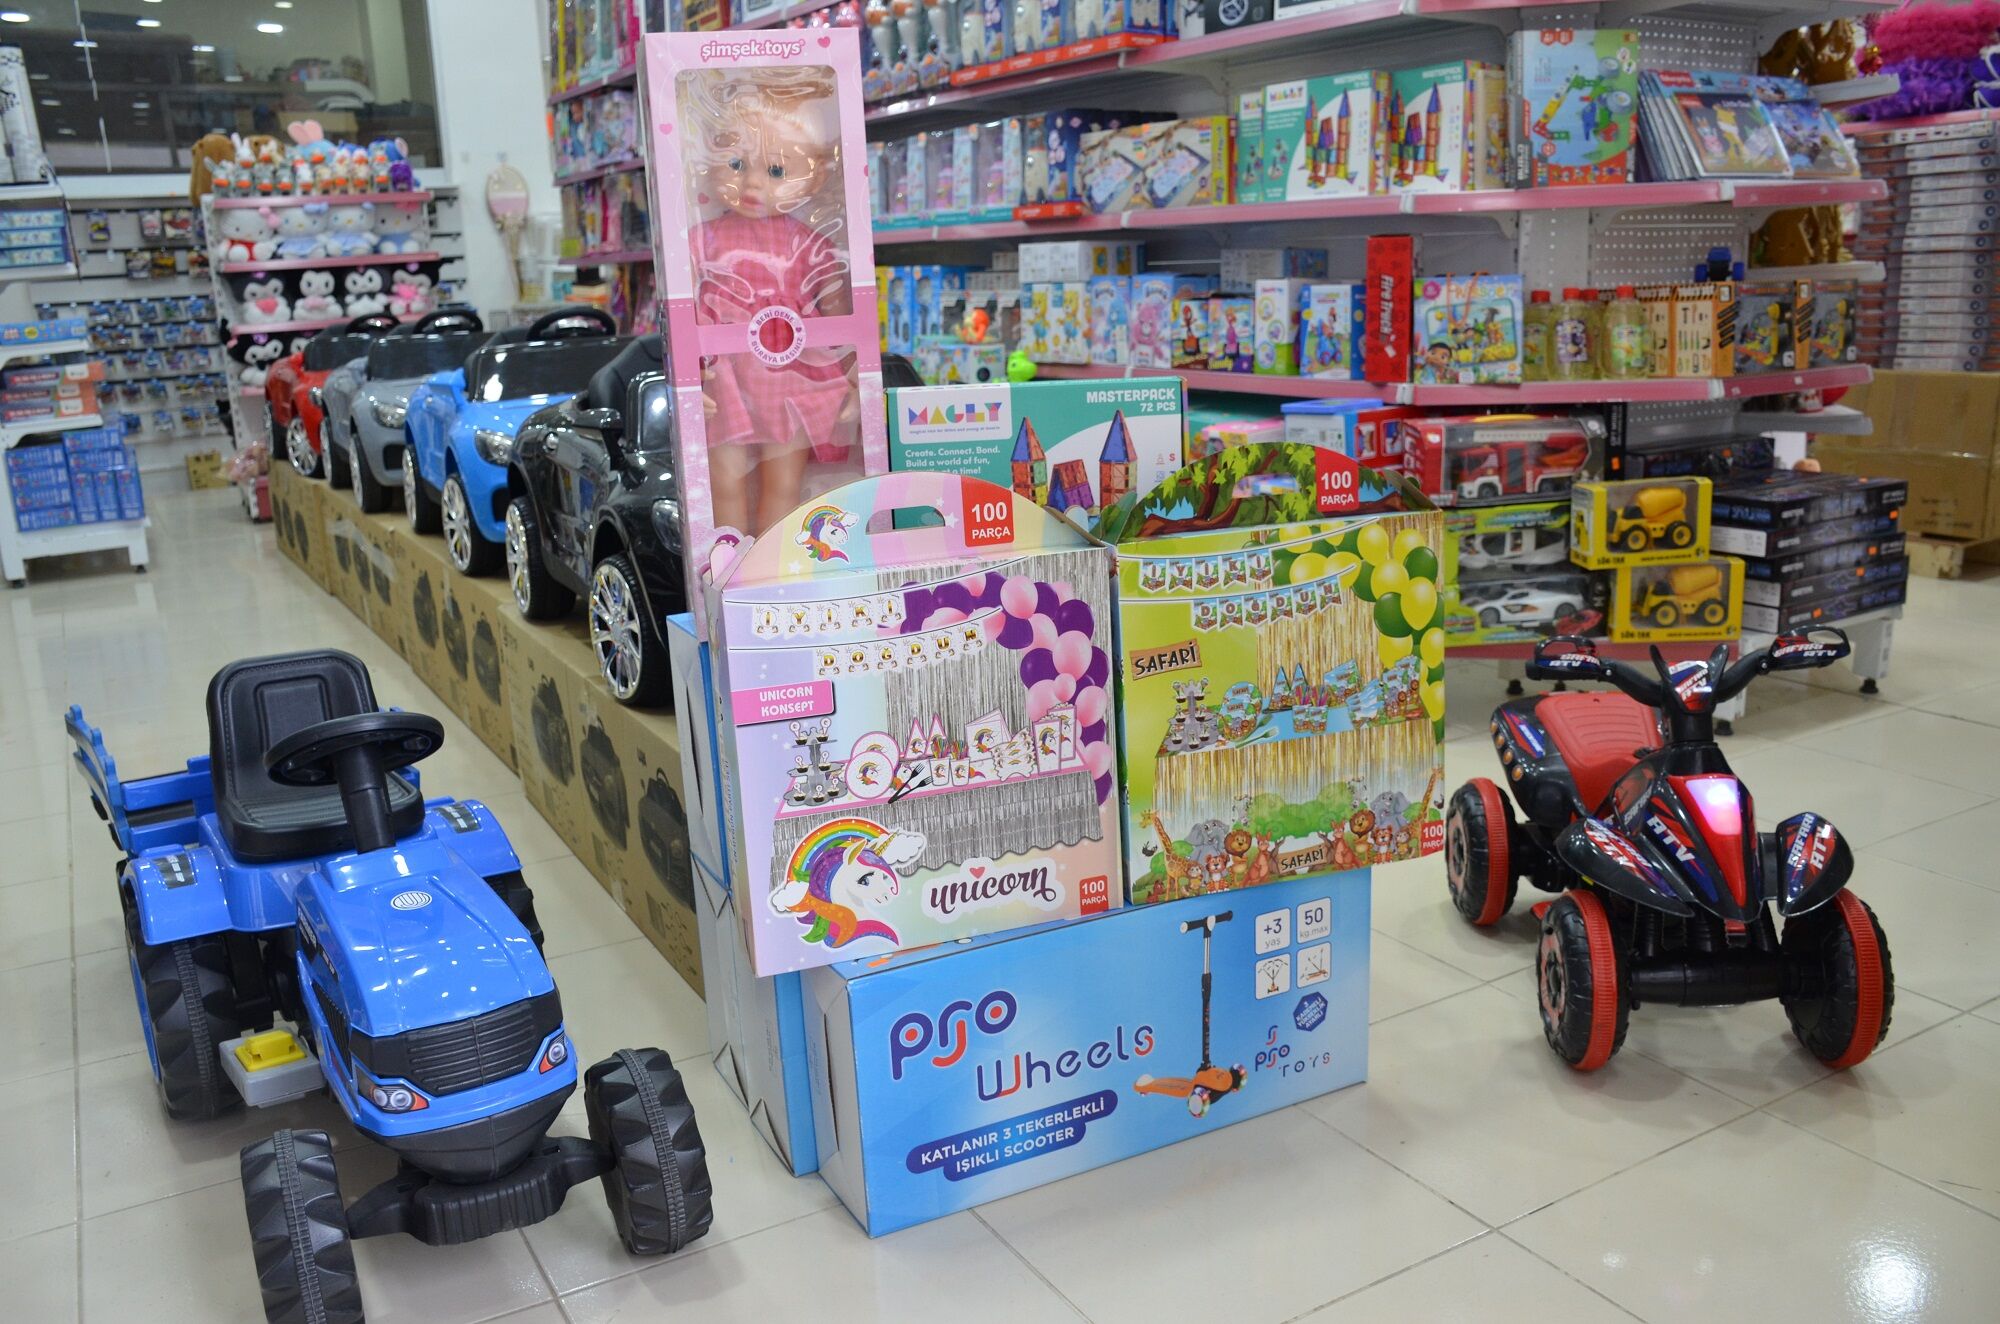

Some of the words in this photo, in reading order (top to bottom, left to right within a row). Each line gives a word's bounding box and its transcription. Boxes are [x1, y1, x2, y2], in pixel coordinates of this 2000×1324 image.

[701, 40, 801, 61] şimşek.toys
[755, 310, 773, 326] BENİ
[774, 310, 794, 323] DENE
[751, 340, 778, 363] BURAYA
[1086, 388, 1176, 403] MASTERPACK
[908, 402, 1003, 425] MAGLY
[1140, 403, 1153, 412] 72
[1156, 401, 1176, 411] PCS
[905, 449, 936, 458] Create.
[938, 446, 975, 457] Connect.
[976, 445, 1001, 454] Bond.
[905, 459, 927, 468] Build
[936, 457, 963, 466] world
[964, 456, 973, 465] of
[973, 456, 990, 465] fun,
[1321, 470, 1352, 490] 100
[1321, 493, 1354, 506] PARÇA
[971, 502, 1008, 523] 100
[972, 526, 1011, 540] PARÇA
[1803, 649, 1837, 657] ATV
[759, 685, 813, 702] UNICORN
[761, 701, 815, 717] KONSEPT
[1423, 824, 1443, 838] 100
[1647, 815, 1695, 861] ATV
[1787, 813, 1815, 867] SAFARI
[930, 866, 1057, 914] unicorn
[1081, 880, 1105, 895] 100
[1081, 895, 1107, 906] PARÇA
[1304, 907, 1323, 926] 50
[1264, 917, 1282, 935] +3
[1265, 938, 1281, 949] yaş
[976, 1025, 1154, 1101] Wheels
[920, 1133, 998, 1166] KATLANIR
[1003, 1127, 1012, 1141] 3
[1015, 1096, 1105, 1137] TEKERLEKLİ
[956, 1152, 1000, 1173] IŞIKLI
[1003, 1126, 1075, 1158] SCOOTER
